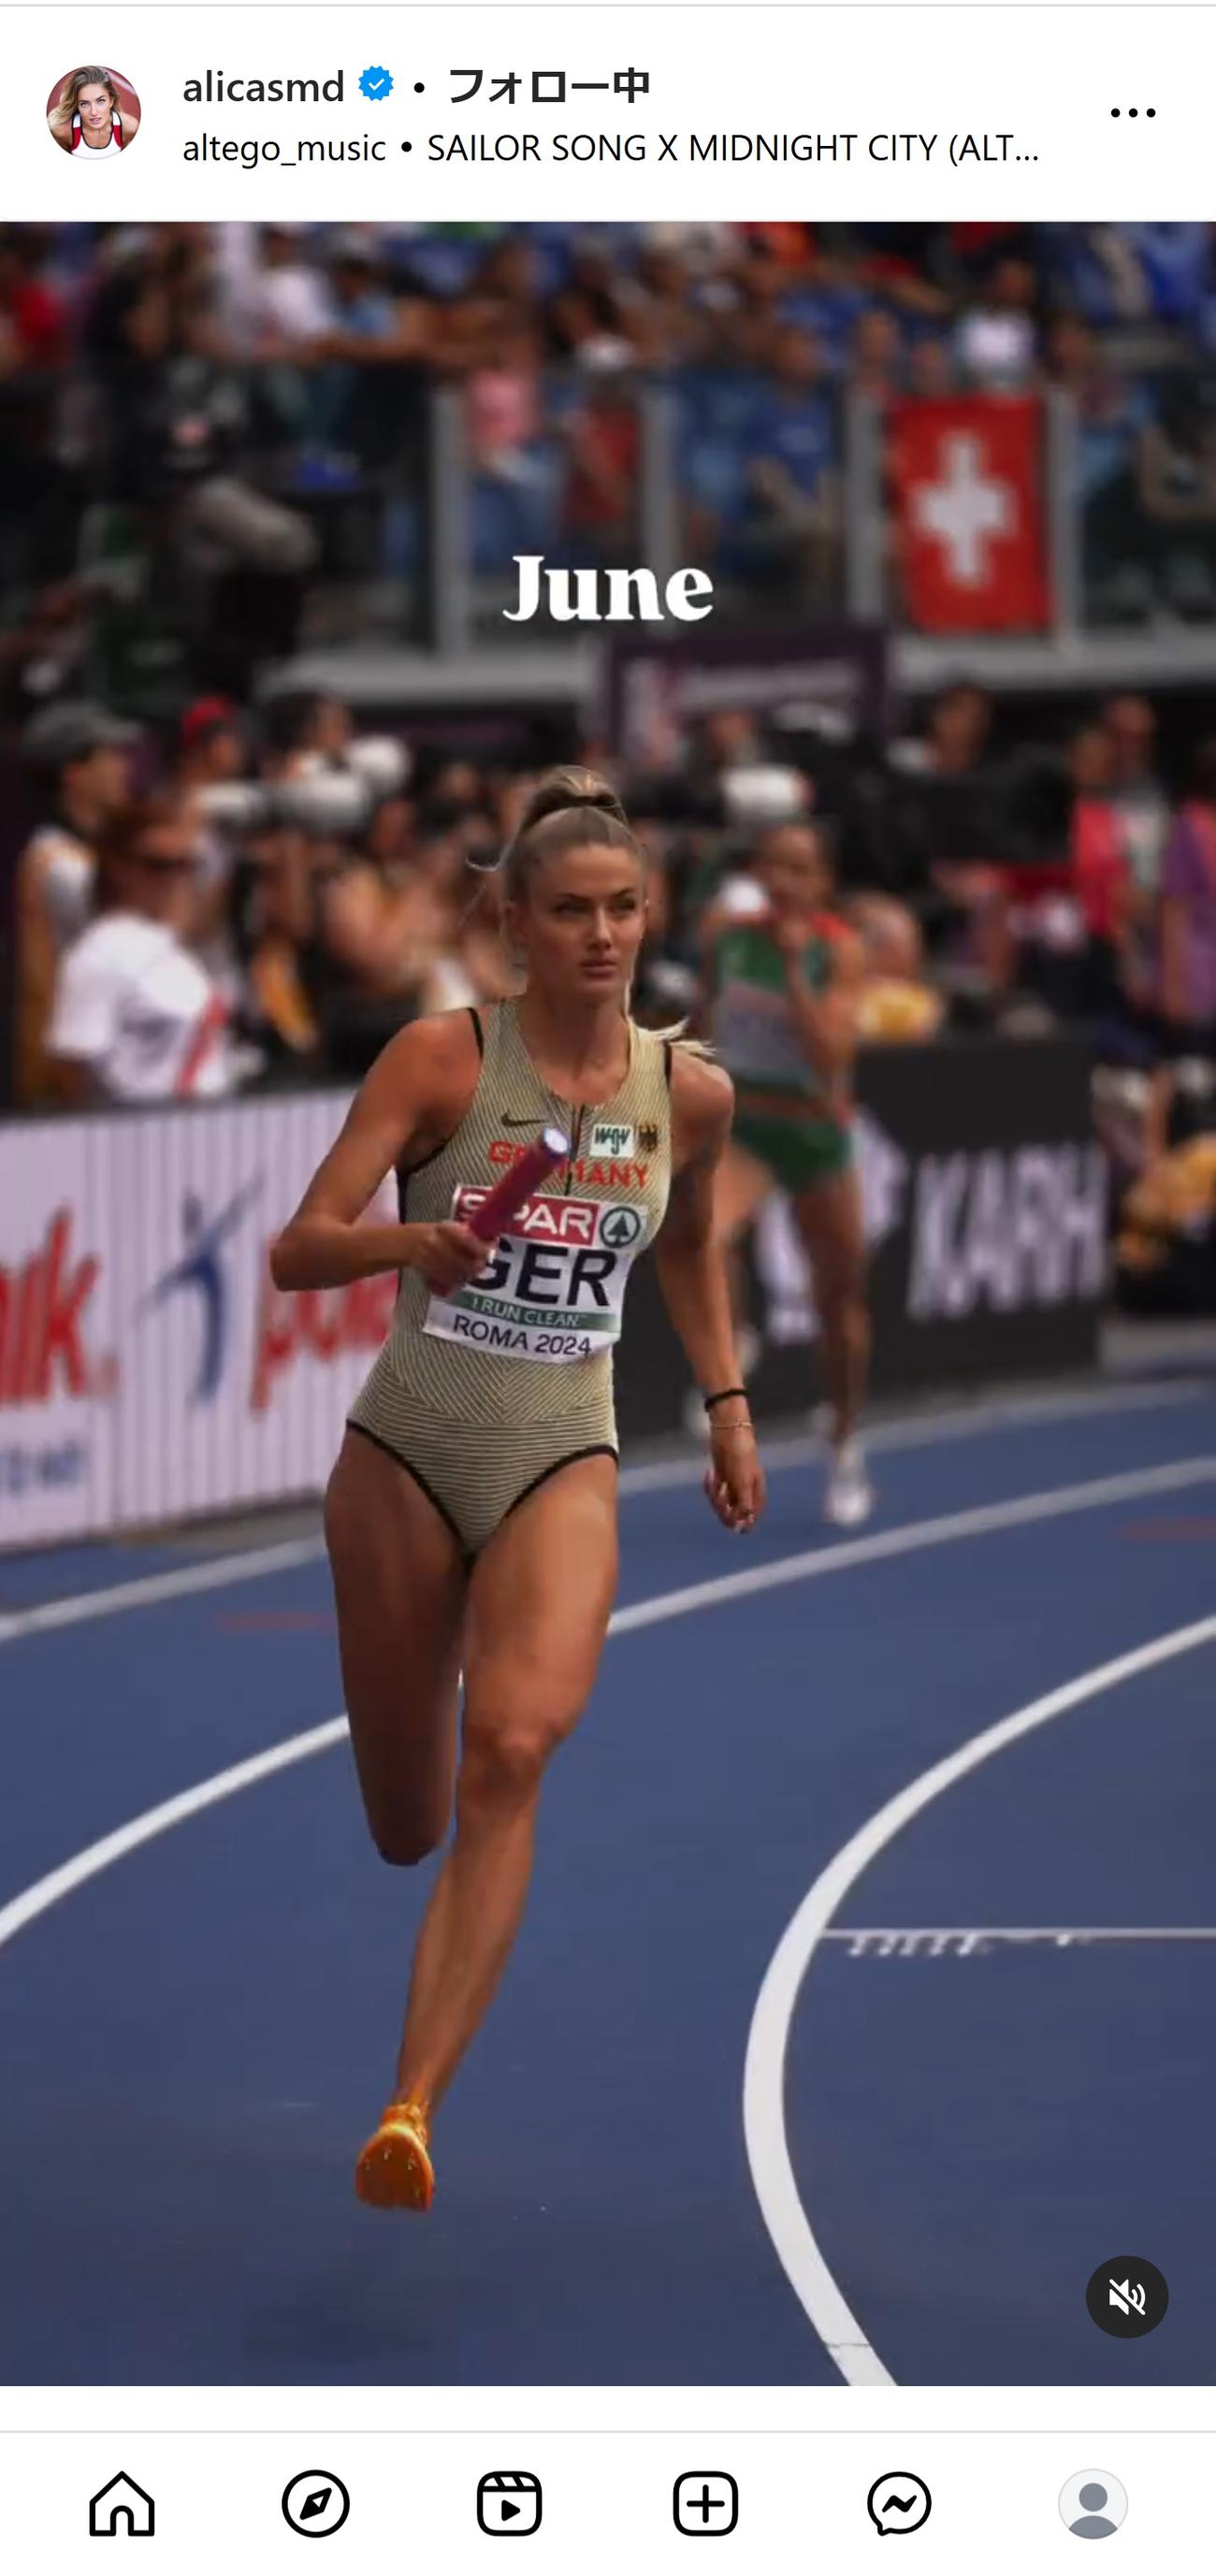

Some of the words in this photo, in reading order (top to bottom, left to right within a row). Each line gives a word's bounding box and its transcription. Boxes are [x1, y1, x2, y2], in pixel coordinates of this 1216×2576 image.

[481, 1297, 521, 1321] RUN
[453, 1313, 528, 1351] ROMA
[534, 1333, 592, 1357] 2024
